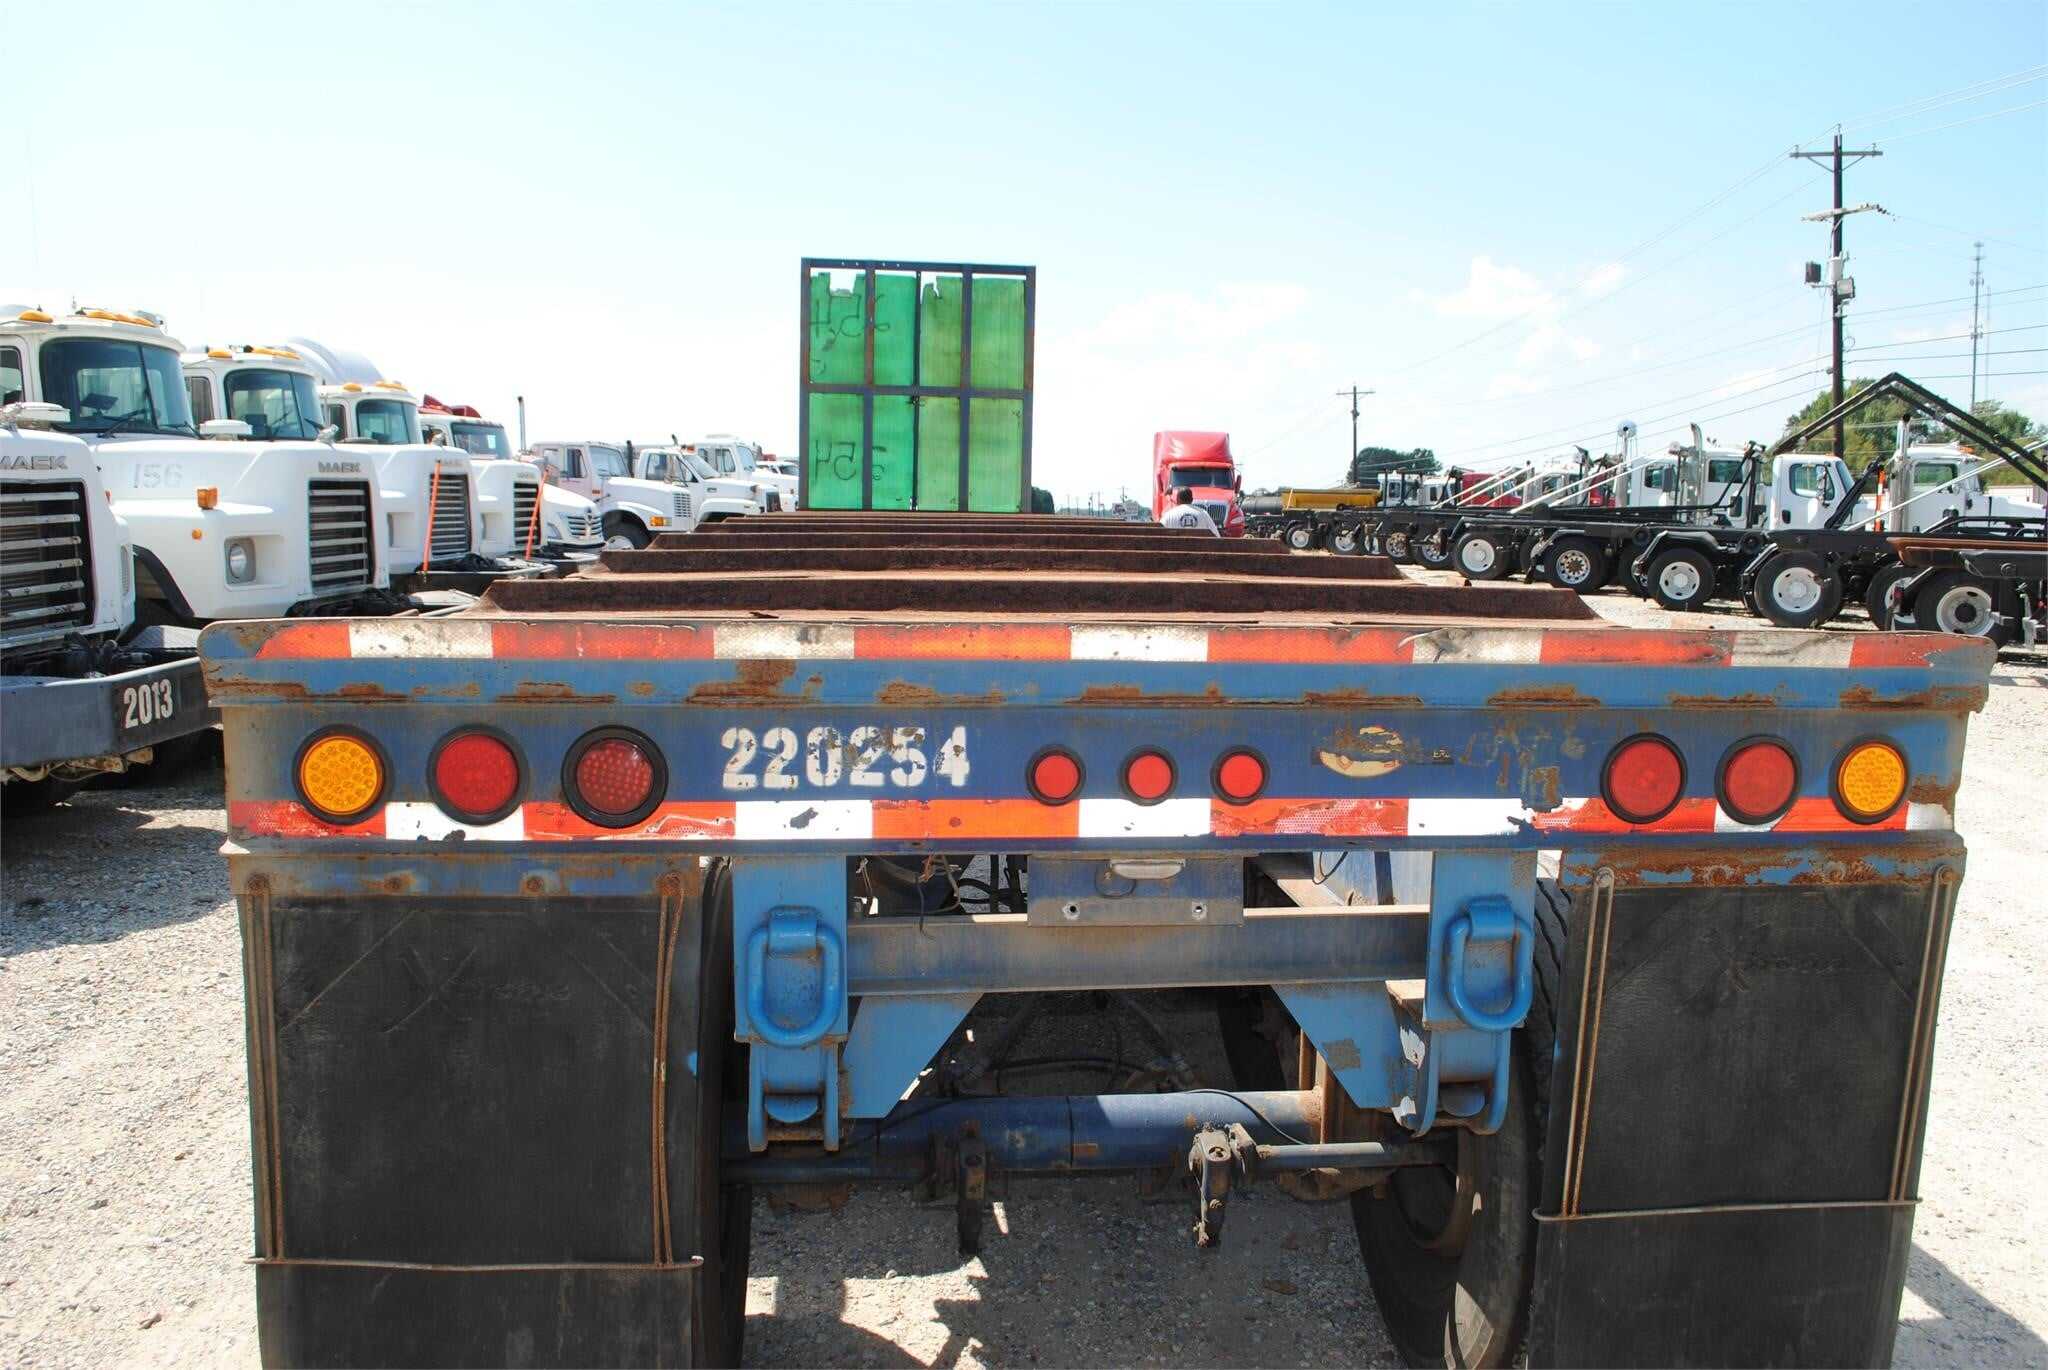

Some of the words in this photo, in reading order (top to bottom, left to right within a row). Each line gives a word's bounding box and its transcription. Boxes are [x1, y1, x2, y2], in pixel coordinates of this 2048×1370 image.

[318, 461, 361, 473] MACK
[123, 678, 174, 729] 2013
[721, 725, 971, 789] 220254
